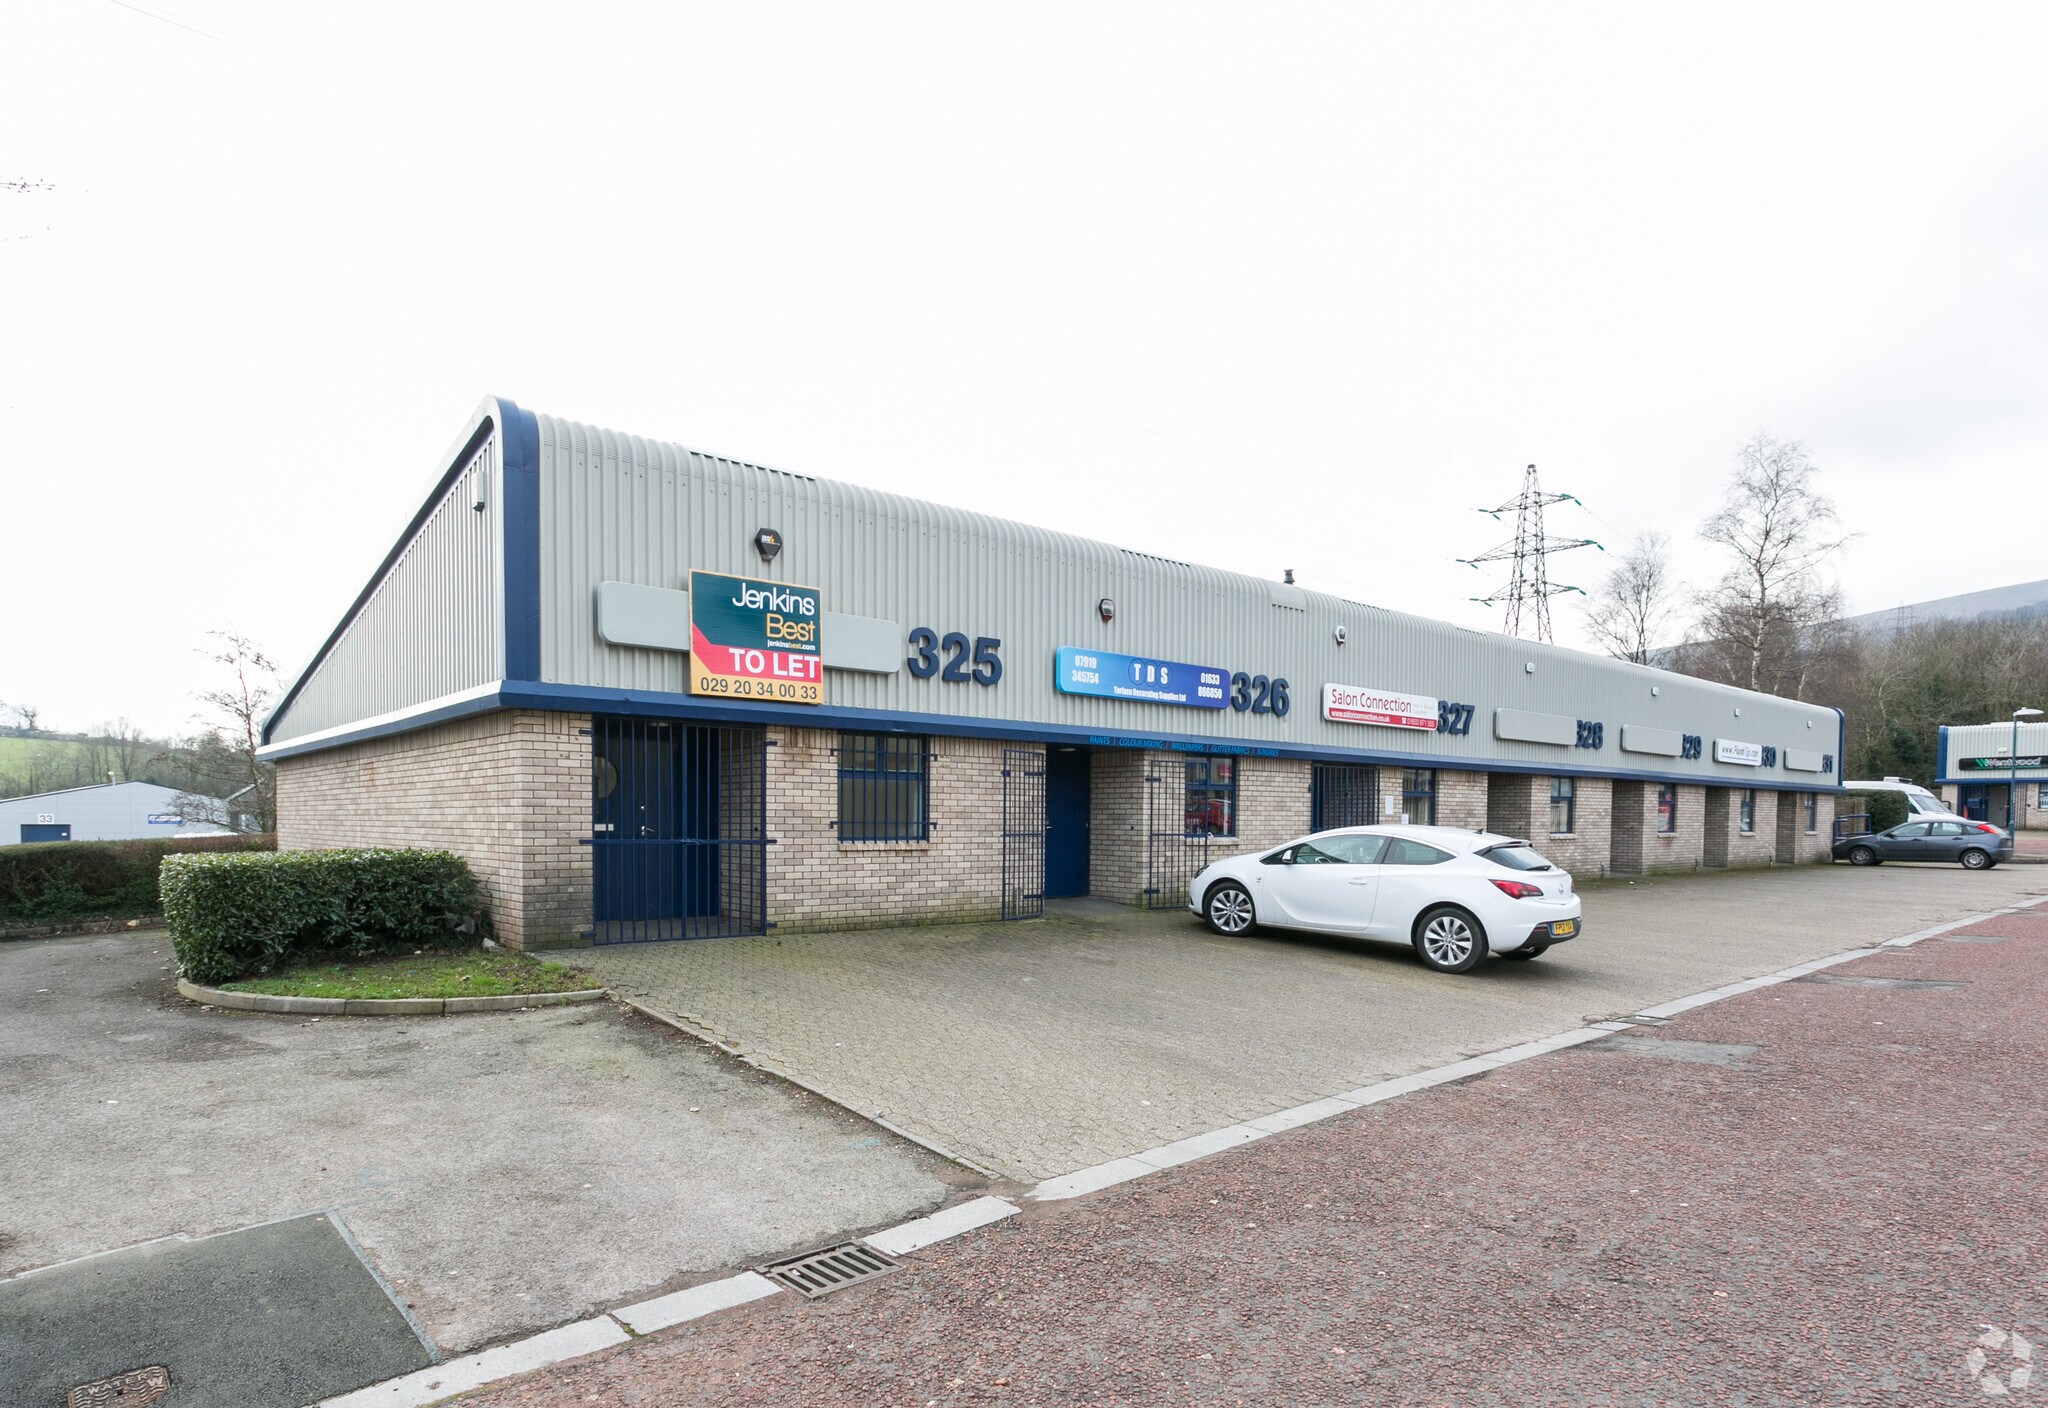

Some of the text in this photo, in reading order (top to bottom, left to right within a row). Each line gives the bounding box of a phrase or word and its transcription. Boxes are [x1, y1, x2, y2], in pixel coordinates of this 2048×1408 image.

[732, 582, 815, 616] Jenkins
[766, 613, 815, 641] Best
[767, 640, 816, 651] jenkinsbest.com
[907, 627, 1002, 686] 325
[729, 648, 820, 678] TO LET
[1075, 655, 1097, 669] 07919
[701, 677, 817, 699] 029 20 34 00 33
[1072, 670, 1099, 684] 345754
[1200, 672, 1220, 685] 01633
[1230, 671, 1290, 717] 326
[1332, 688, 1411, 714] Salon Connection
[1438, 700, 1475, 736] 327
[1090, 735, 1110, 745] PAINTS
[1171, 742, 1204, 752] WALLPAPERS
[40, 815, 53, 823] 33
[88, 1374, 147, 1395] WATER
